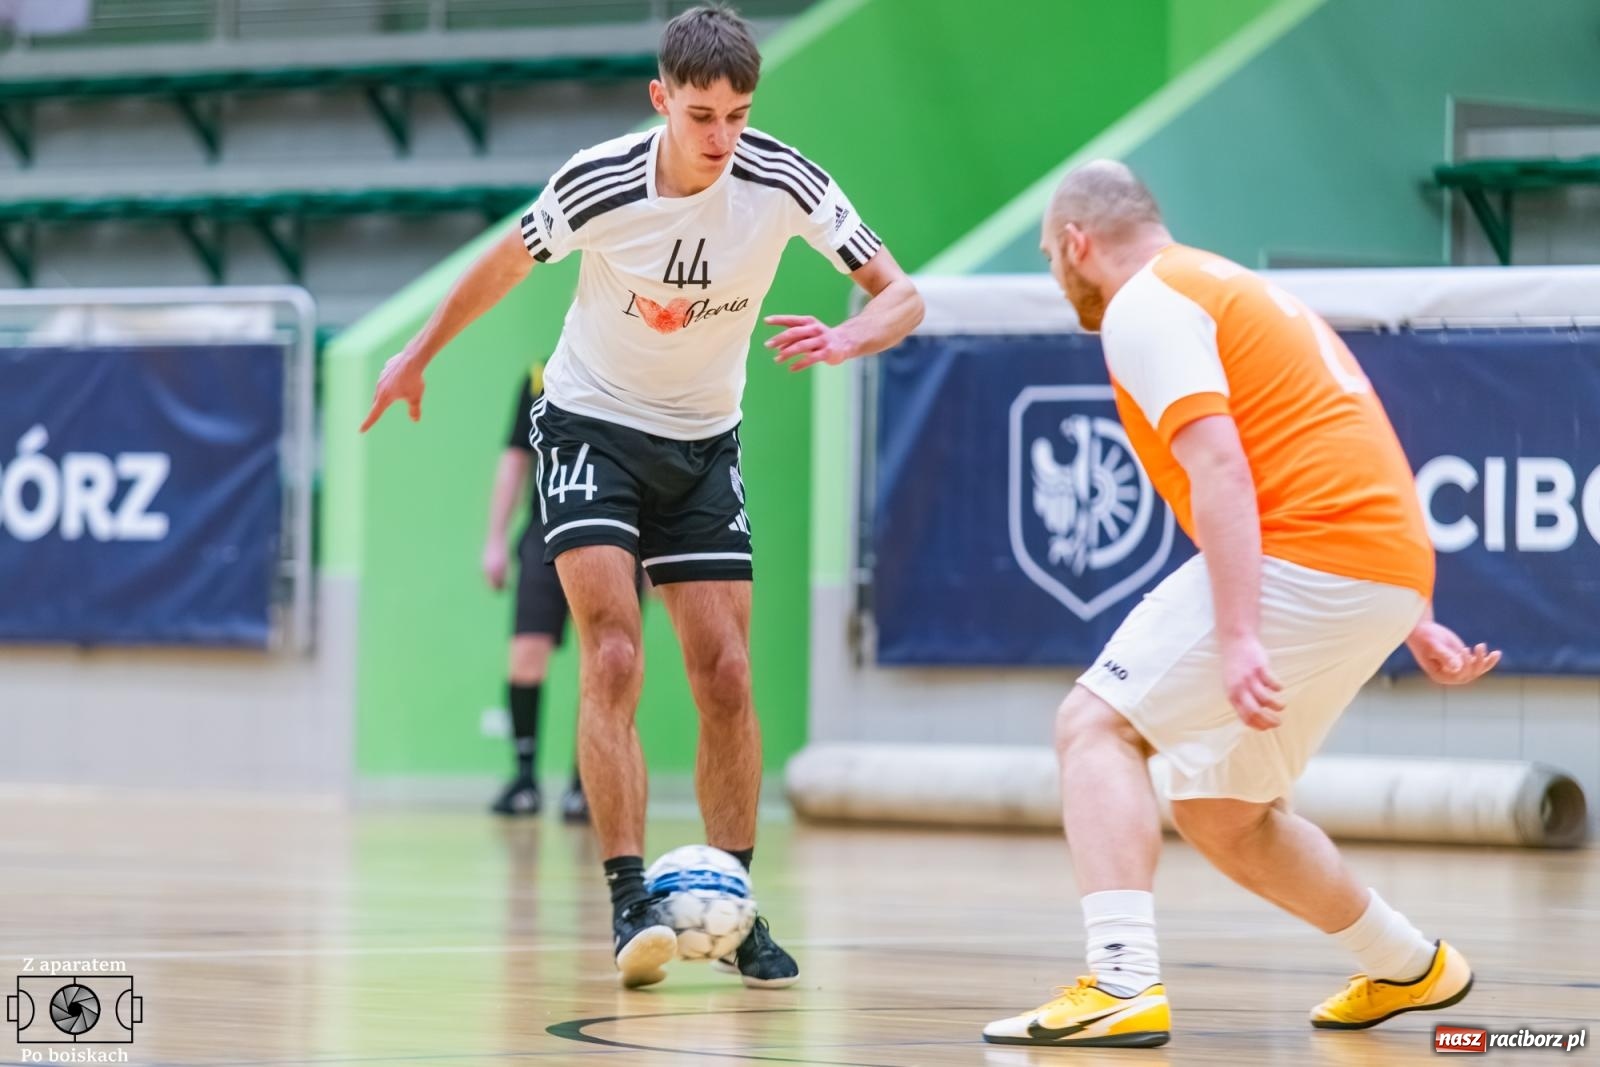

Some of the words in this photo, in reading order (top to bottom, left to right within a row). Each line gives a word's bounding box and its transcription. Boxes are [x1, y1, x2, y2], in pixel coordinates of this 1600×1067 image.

[662, 237, 712, 290] 44
[0, 424, 171, 541] ÓRZ
[547, 442, 598, 504] 44
